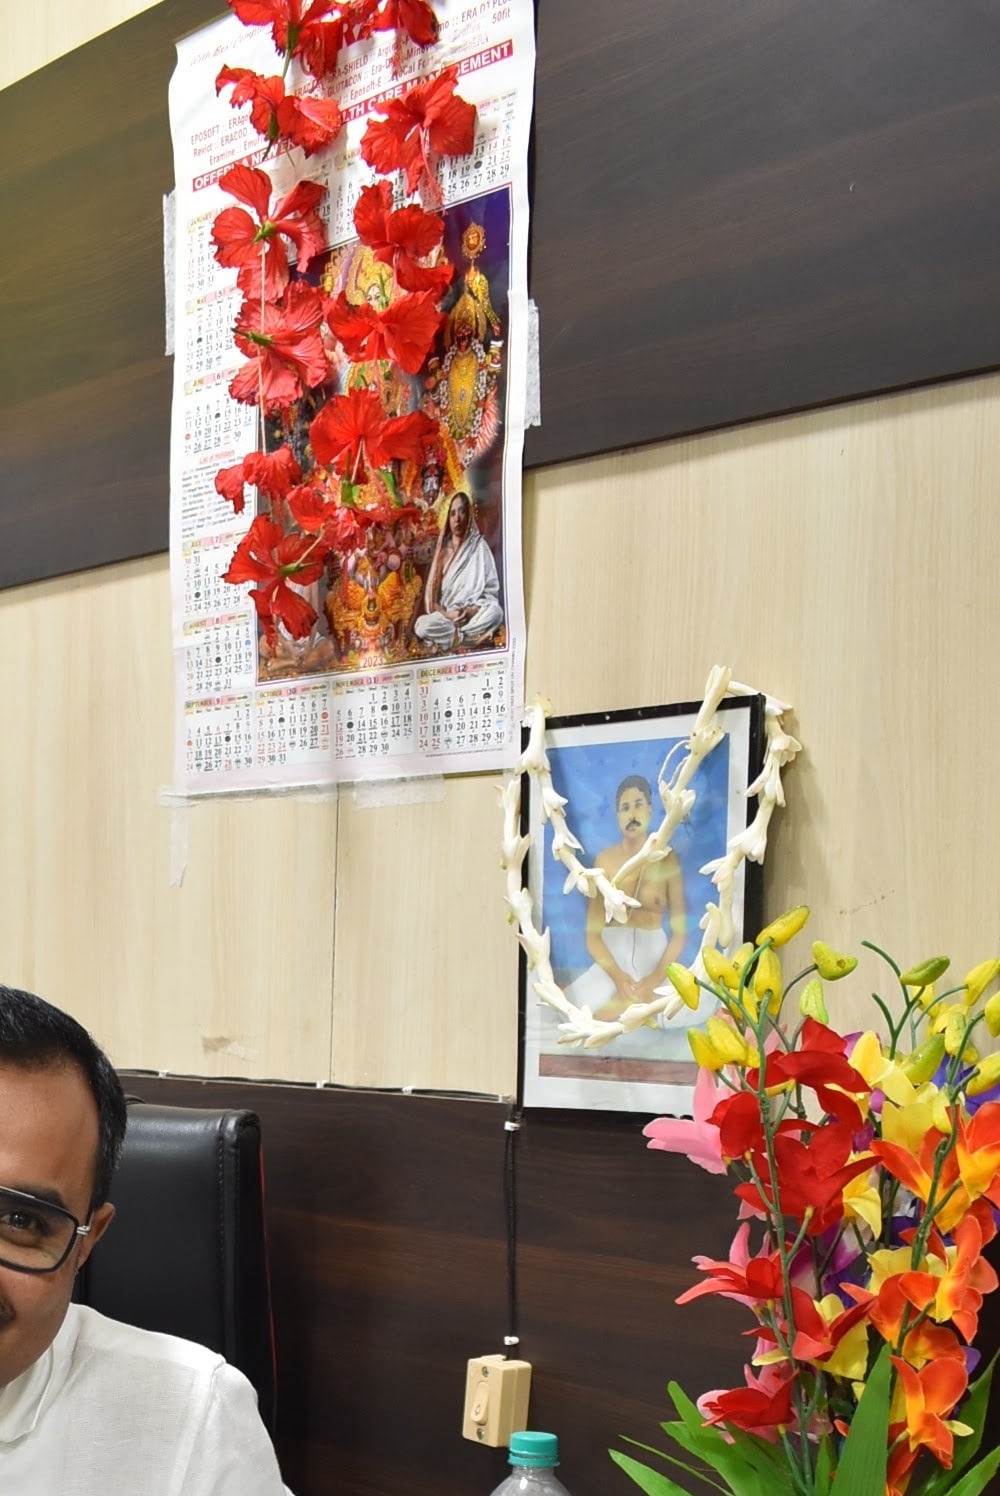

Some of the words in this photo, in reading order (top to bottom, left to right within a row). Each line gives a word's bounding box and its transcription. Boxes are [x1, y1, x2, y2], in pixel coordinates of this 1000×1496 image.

[190, 127, 220, 146] EPOSOFT
[209, 148, 235, 165] Eramine
[363, 656, 384, 669] 2023
[485, 678, 490, 687] 1
[499, 676, 504, 686] 2
[421, 700, 427, 708] 3
[434, 698, 439, 707] 4
[446, 696, 451, 705] 5
[459, 695, 464, 704] 6
[471, 693, 477, 702] 7
[498, 690, 504, 699] 9
[420, 713, 428, 721] 10
[433, 711, 440, 720] 11
[457, 709, 466, 717] 13
[469, 707, 478, 716] 14
[482, 705, 492, 714] 15
[495, 704, 506, 713] 16
[357, 720, 366, 729] 14
[369, 719, 378, 727] 15
[380, 717, 389, 726] 16
[391, 716, 400, 725] 17
[403, 714, 412, 723] 18
[420, 726, 428, 735] 17
[432, 725, 441, 733] 18
[444, 723, 453, 732] 19
[456, 722, 466, 731] 20
[469, 721, 479, 729] 21
[481, 719, 492, 728] 22
[346, 734, 355, 743] 20
[358, 733, 366, 741] 21
[369, 731, 378, 740] 22
[391, 729, 400, 738] 24
[403, 728, 413, 736] 25
[419, 739, 428, 748] 24
[431, 737, 441, 747] 25
[456, 735, 466, 744] 27
[469, 734, 478, 743] 28
[481, 733, 491, 741] 29
[495, 731, 504, 740] 30
[357, 745, 367, 754] 28
[369, 744, 378, 753] 29
[380, 743, 389, 751] 30
